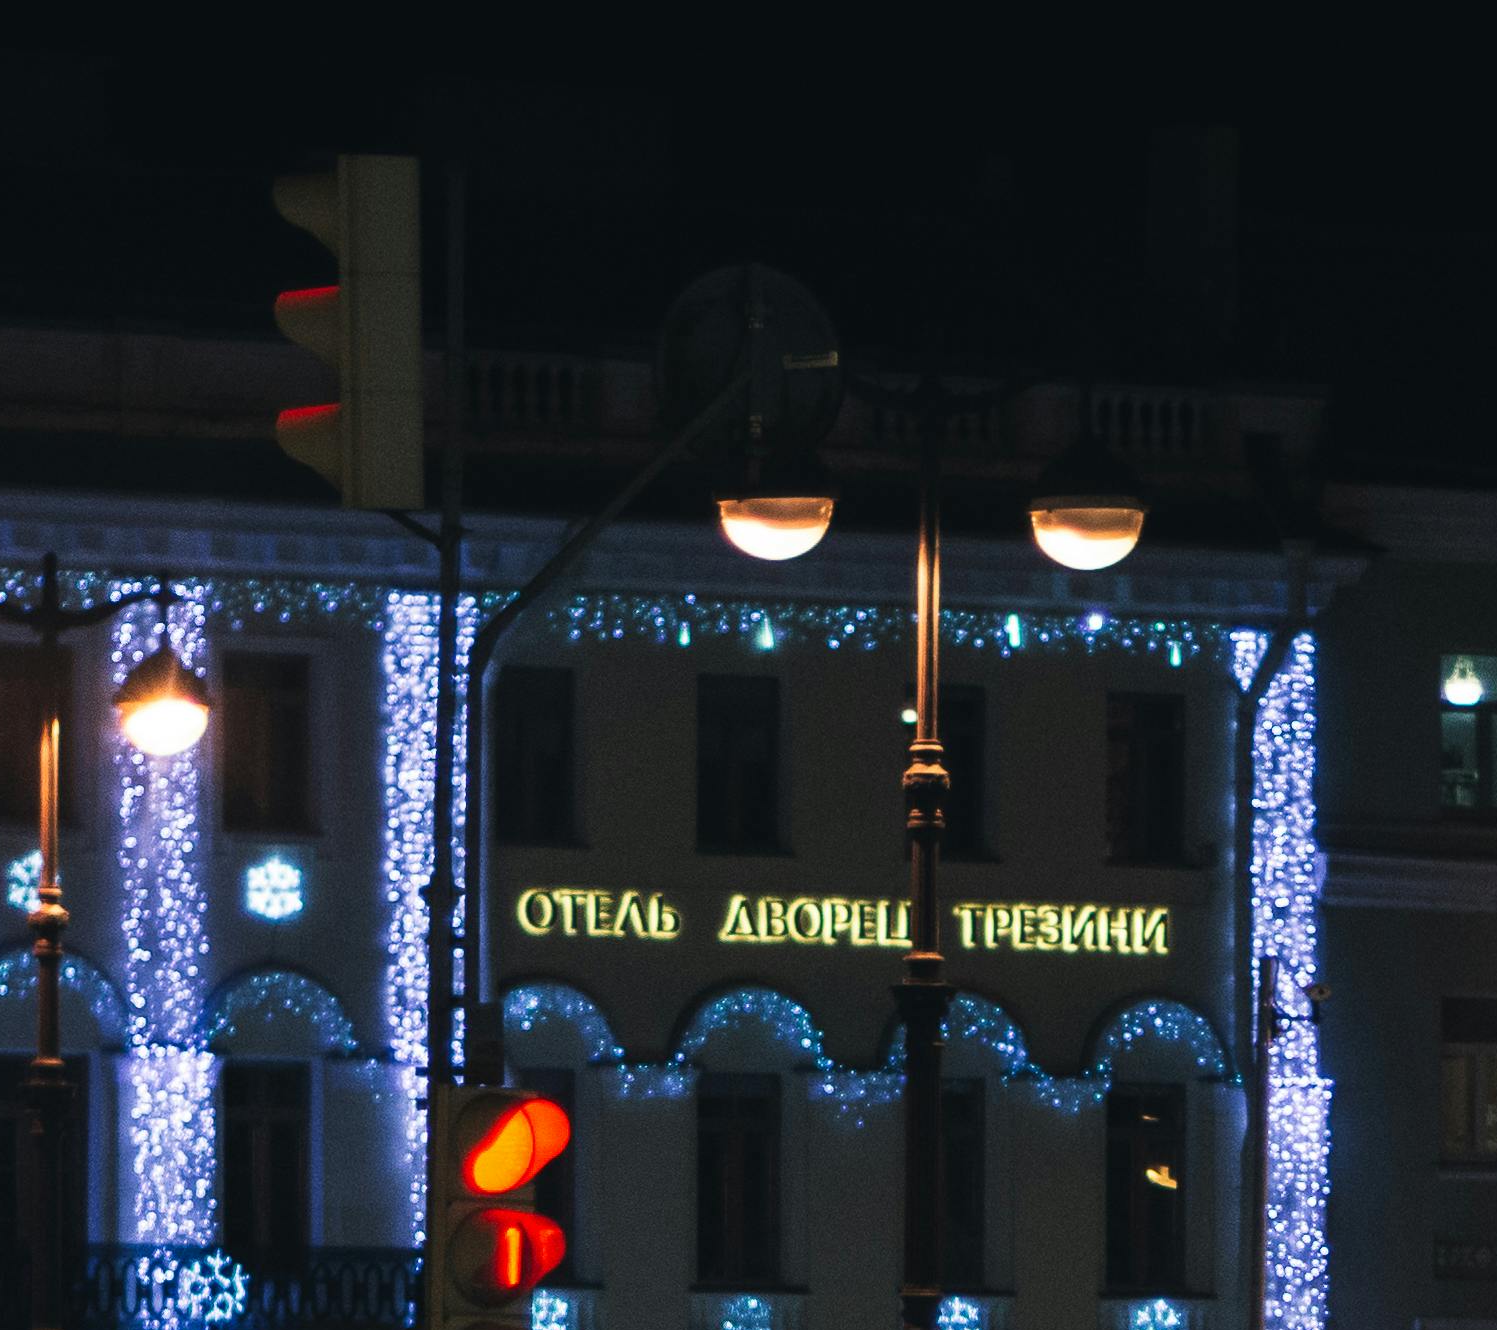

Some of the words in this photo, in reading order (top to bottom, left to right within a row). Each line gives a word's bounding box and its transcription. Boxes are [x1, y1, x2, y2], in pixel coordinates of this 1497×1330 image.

[516, 887, 682, 940] ОТЕЛЬ
[717, 893, 913, 948] ДВОРЕЦ
[953, 902, 1169, 955] ТРЕЗИНИ
